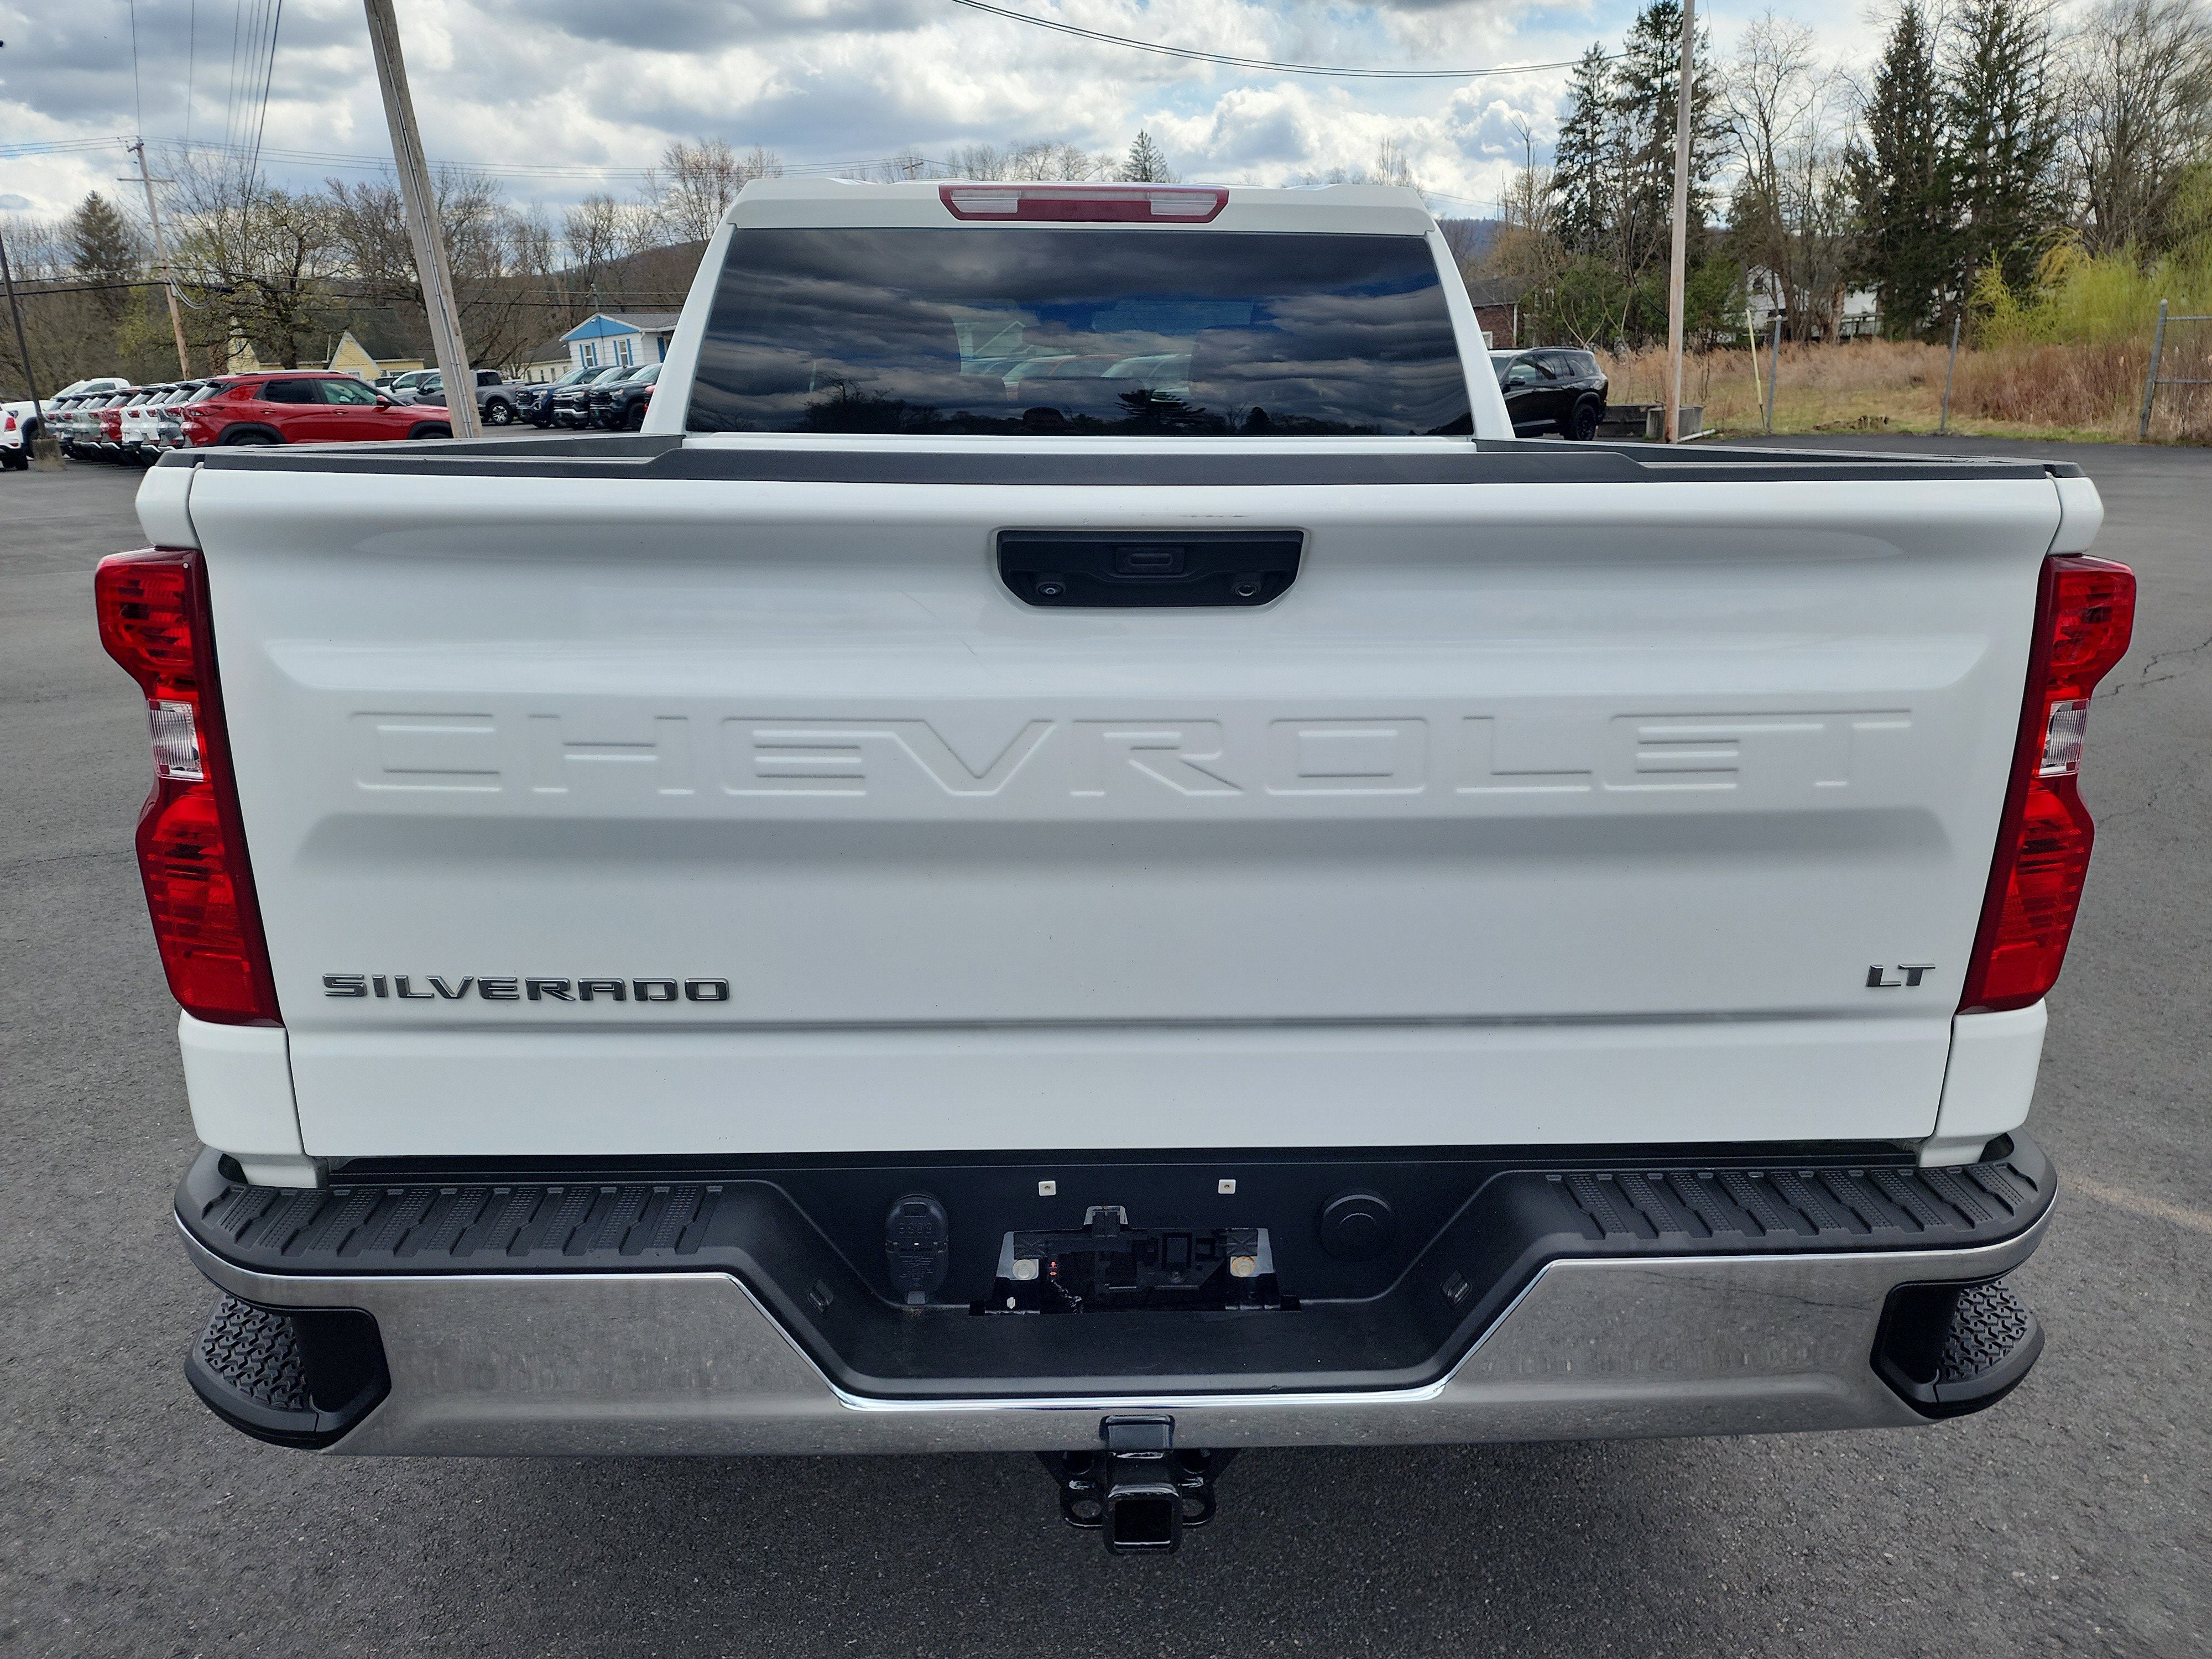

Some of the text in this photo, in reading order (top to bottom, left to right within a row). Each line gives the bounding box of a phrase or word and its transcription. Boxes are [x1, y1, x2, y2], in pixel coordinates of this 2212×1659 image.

[351, 709, 1912, 797] CHEVROLET
[322, 973, 729, 1001] SILVERADO
[1866, 963, 1936, 987] LT
